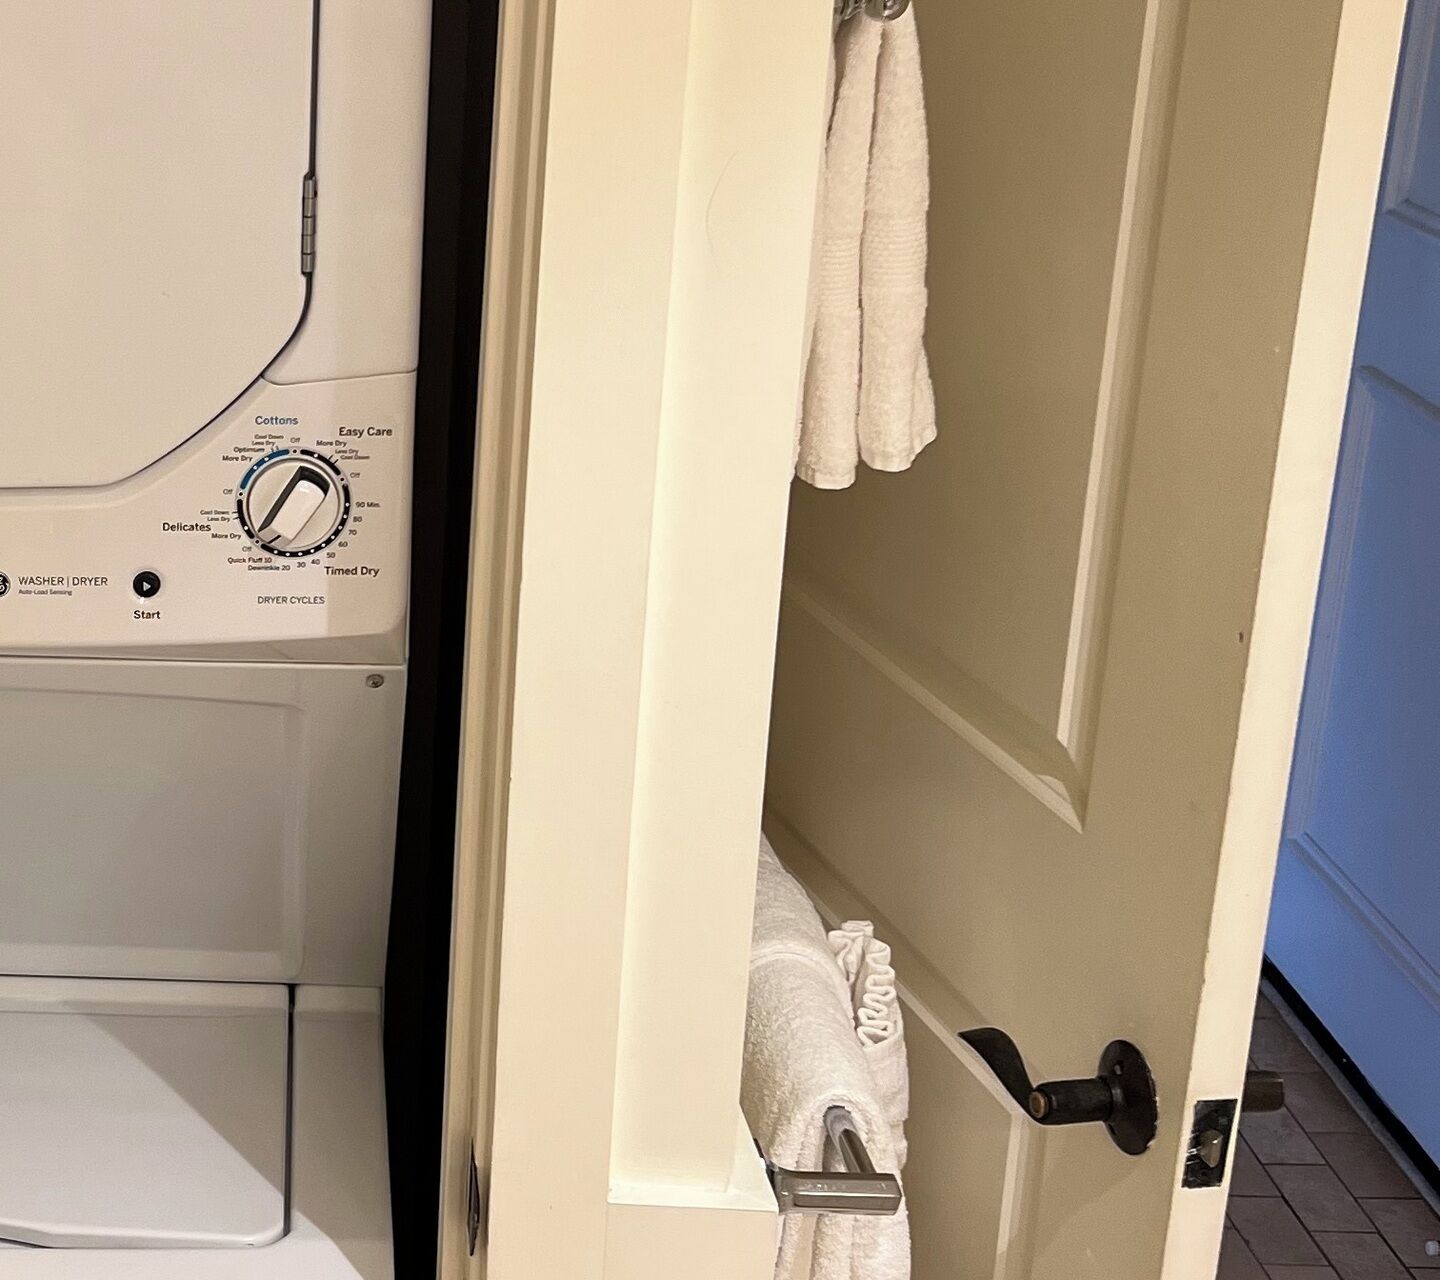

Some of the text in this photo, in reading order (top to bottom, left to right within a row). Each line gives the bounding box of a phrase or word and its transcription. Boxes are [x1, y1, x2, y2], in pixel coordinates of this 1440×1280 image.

[255, 415, 299, 426] Cottons
[338, 426, 393, 439] Easy Care
[335, 440, 347, 448] Dry
[241, 455, 253, 463] Dry
[223, 488, 234, 496] Off
[356, 501, 366, 509] 90
[162, 522, 212, 533] Delicates
[211, 532, 242, 541] More Dry
[241, 545, 252, 553] Off
[227, 556, 273, 565] Quick Fluff 10
[296, 561, 307, 569] 30
[311, 558, 321, 566] 40
[281, 564, 291, 572] 20
[324, 566, 381, 579] Timed Dry
[17, 576, 65, 587] WASHER
[71, 576, 109, 587] DRYER
[48, 588, 73, 597] Sensing
[257, 596, 326, 605] DRYER CYCLES
[133, 610, 161, 621] Start
